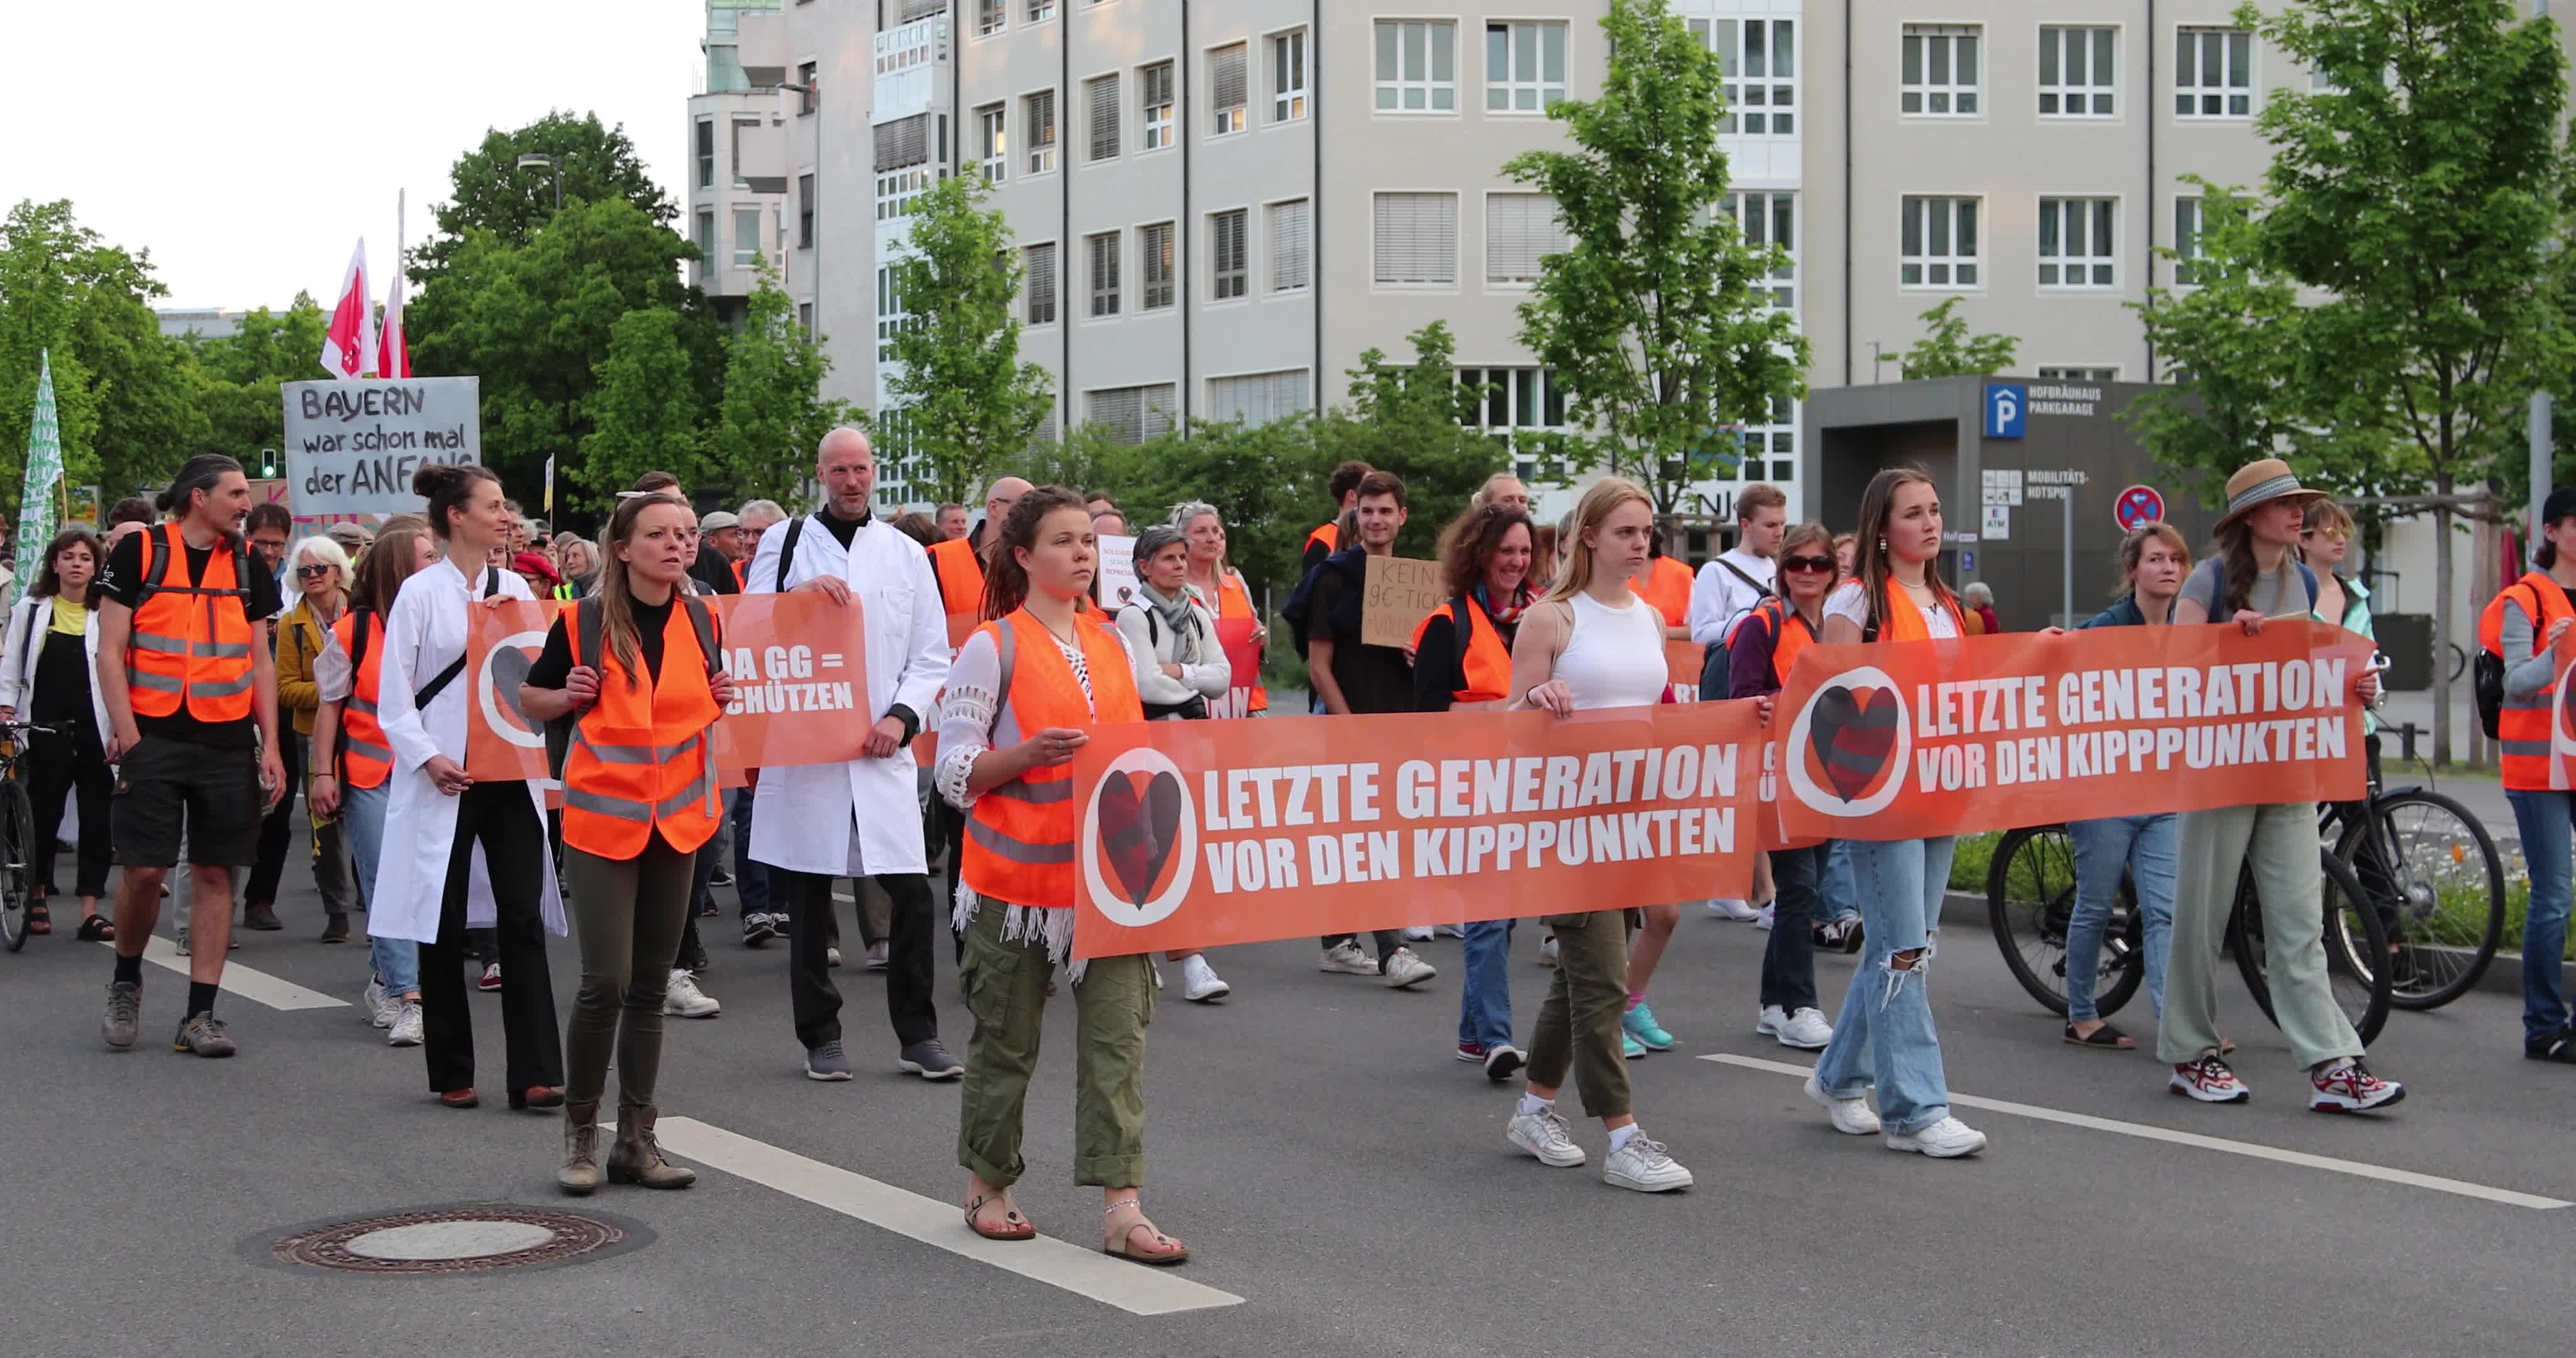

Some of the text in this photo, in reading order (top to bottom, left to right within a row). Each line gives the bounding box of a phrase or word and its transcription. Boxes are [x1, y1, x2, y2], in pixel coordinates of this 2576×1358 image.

[301, 387, 425, 422] BAYERN
[2028, 384, 2101, 400] HOFBRÄUHAUS
[2028, 401, 2094, 416] PARKGARAGE
[303, 423, 465, 454] war schon mal
[305, 466, 346, 495] der
[350, 452, 473, 495] ANF
[2027, 468, 2090, 484] MOBILITÄTS-
[1382, 561, 1435, 585] KEIN
[764, 645, 812, 680] GG
[1917, 658, 2347, 738] LETZTE GENERATION
[1917, 715, 2346, 793] VOR DEN KIPPPUNKTEN
[1204, 762, 1380, 831] LETZTE
[1396, 743, 1738, 819] GENERATION
[1204, 807, 1735, 894] VOR DEN KIPPPUNKTEN
